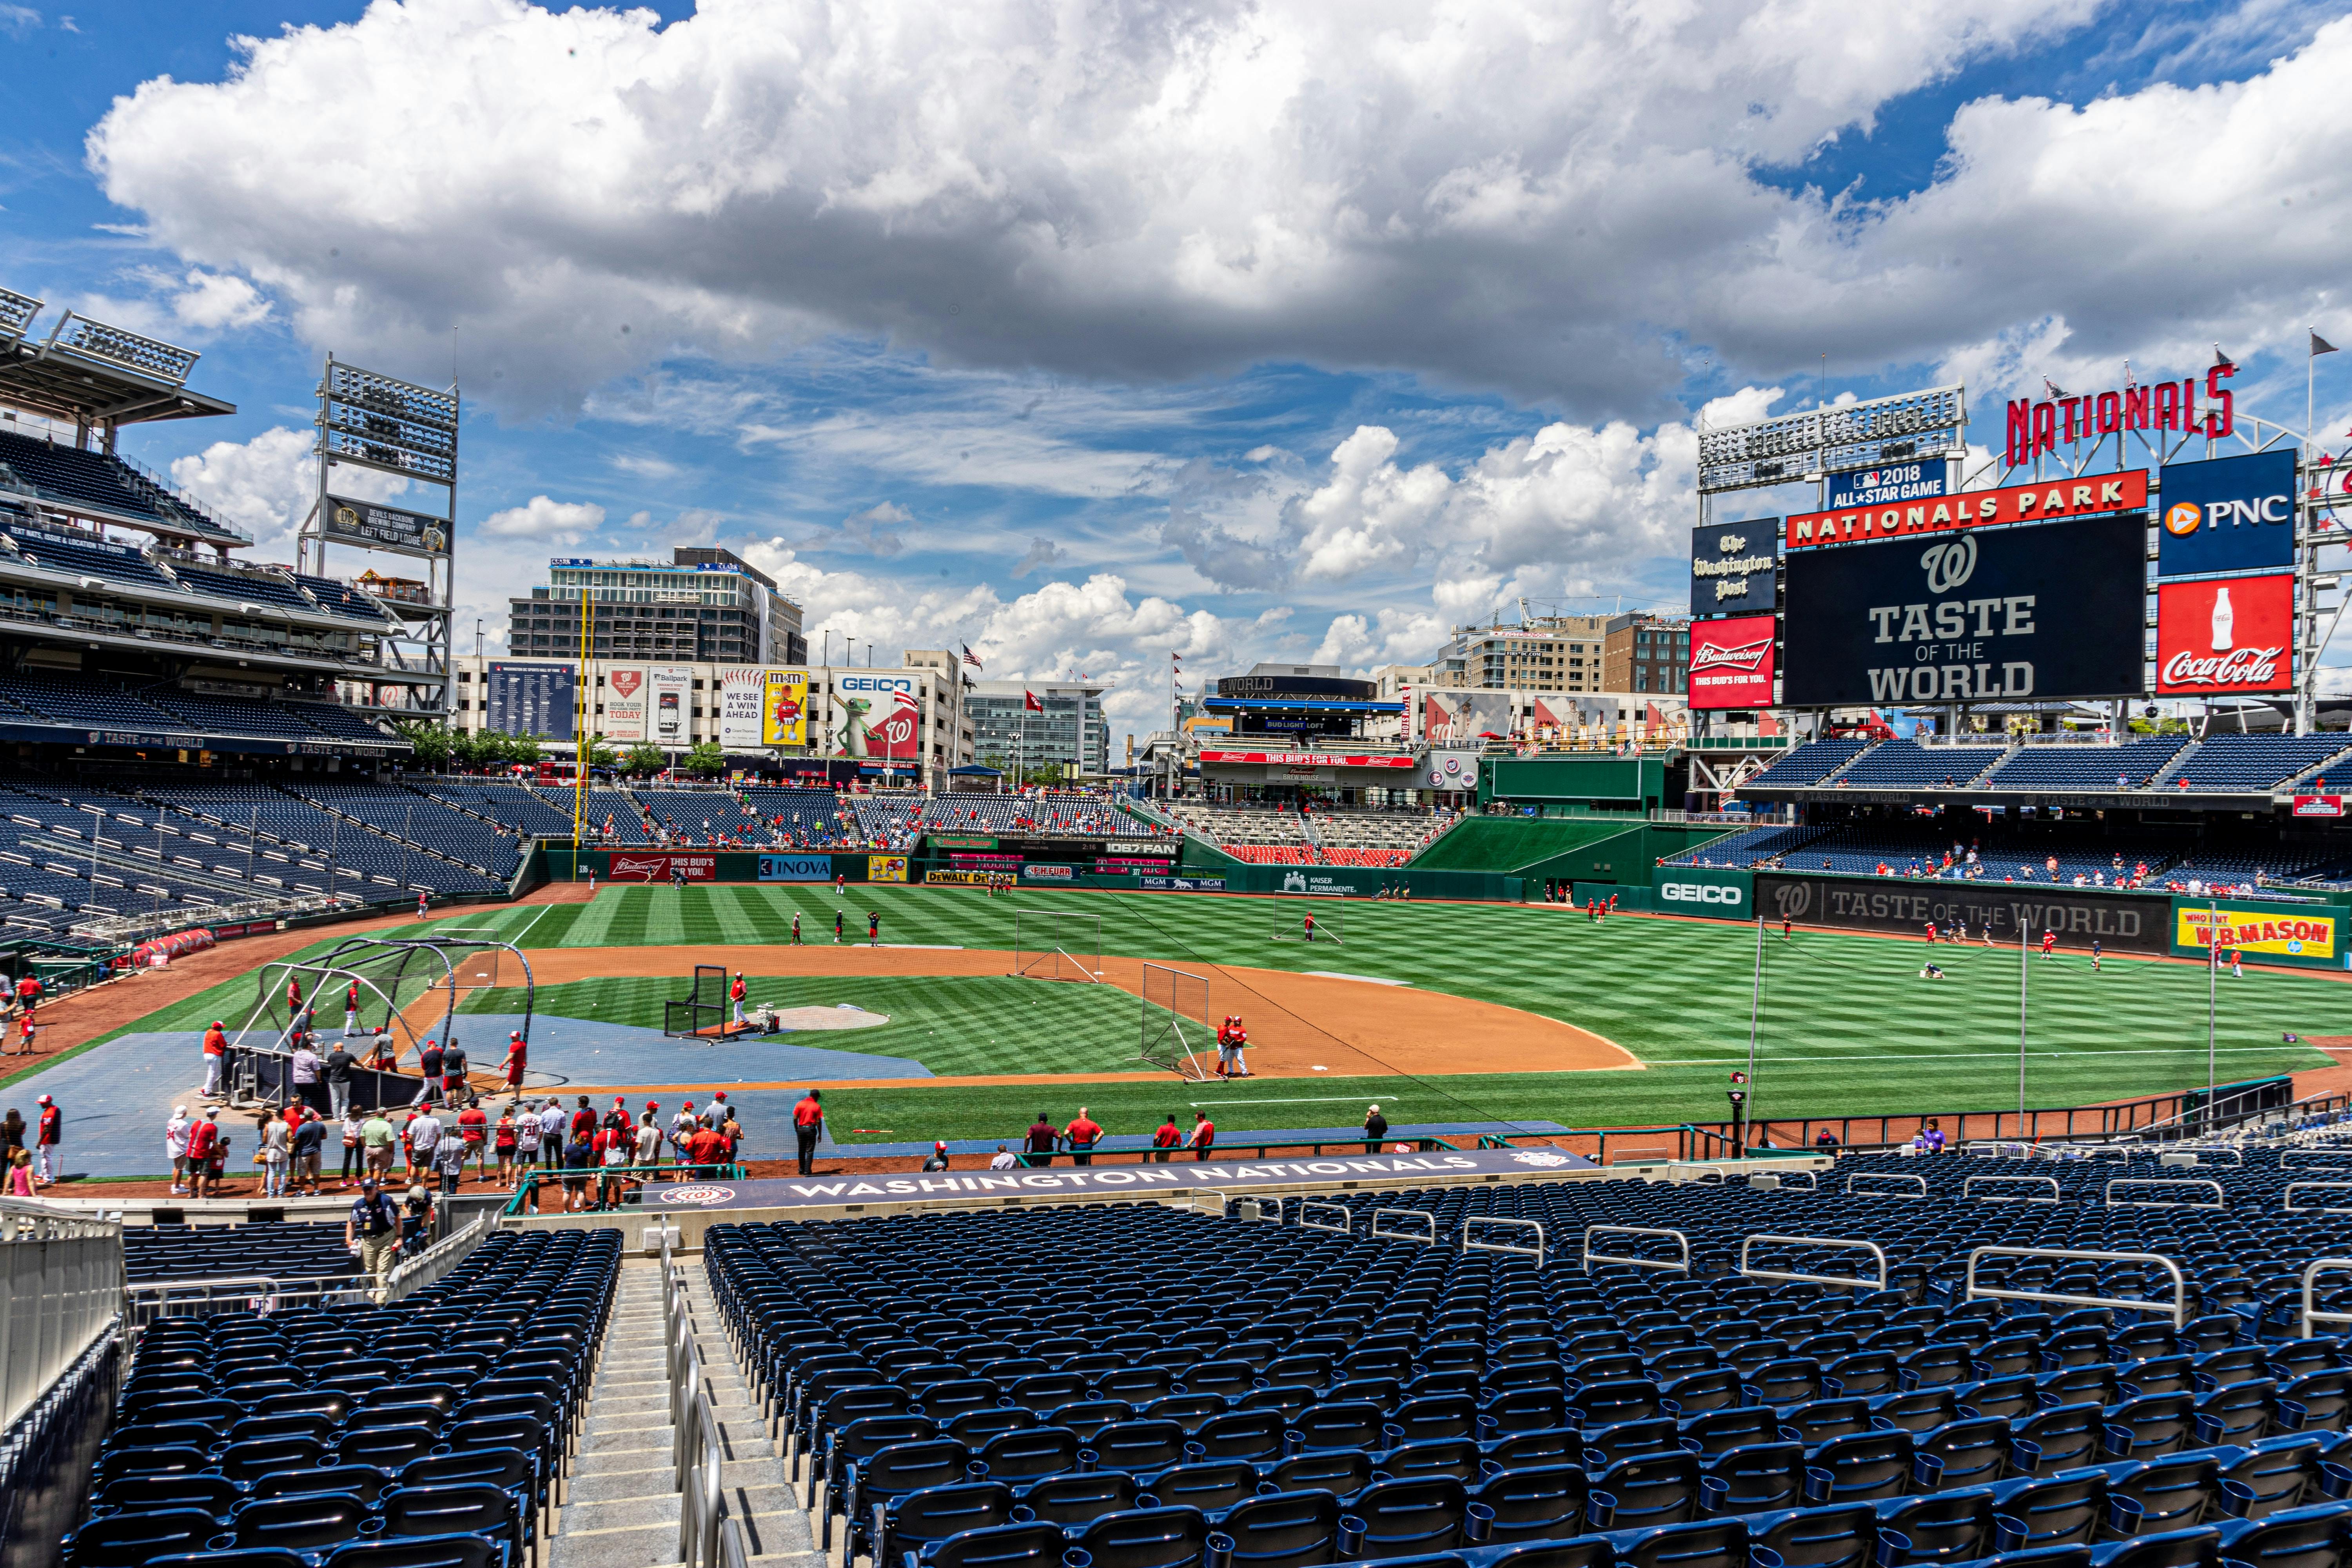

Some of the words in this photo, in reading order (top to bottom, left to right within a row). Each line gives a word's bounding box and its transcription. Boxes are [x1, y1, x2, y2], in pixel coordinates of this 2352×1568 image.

[2006, 363, 2234, 467] NATIONALS
[1882, 465, 1920, 486] 2018
[1901, 479, 1942, 499] GAME
[369, 509, 387, 519] DEVILS
[388, 513, 415, 524] BACKBONE
[1797, 497, 1997, 540] NATIONALS
[2019, 481, 2123, 513] PARK
[2205, 495, 2288, 528] PNC
[368, 515, 391, 528] BREWING
[392, 521, 416, 532] COMPANY
[44, 533, 62, 543] ISSUE
[68, 538, 96, 549] LOCATION
[361, 525, 378, 537] LEFT
[379, 530, 398, 541] FIELD
[400, 533, 421, 546] LODGE
[1720, 535, 1746, 553] The
[1693, 555, 1774, 576] Washington
[1715, 578, 1748, 601] Post
[1869, 595, 2036, 643] TASTE
[1696, 649, 1763, 663] Budweiser
[1916, 645, 1940, 661] OF
[1945, 642, 1984, 660] THE
[2162, 646, 2284, 684] Coca-Cola
[842, 677, 911, 692] GEICO
[1228, 677, 1273, 691] WORLD
[1695, 677, 1711, 686] THIS
[1711, 676, 1733, 685] BUD'S
[1734, 675, 1748, 684] FOR
[1749, 675, 1766, 683] YOU.
[1867, 661, 2034, 701] WORLD
[609, 711, 641, 719] TODAY
[1402, 699, 1410, 716] TEAM
[1401, 717, 1410, 738] STORE
[105, 733, 140, 744] TASTE
[165, 737, 204, 748] WORLD
[301, 744, 332, 755] TASTE
[355, 747, 387, 757] WORLD
[1266, 753, 1283, 762] THIS
[1285, 754, 1310, 764] BUD'S
[1312, 755, 1328, 764] FOR
[1330, 756, 1348, 765] YOU.
[2042, 795, 2085, 806] TASTE
[2118, 796, 2170, 807] WORLD
[1107, 843, 1140, 853] 106.7
[1143, 844, 1176, 854] FAN
[670, 858, 688, 866] THIS
[690, 858, 714, 866] BUD'S
[777, 861, 829, 874] INOVA
[687, 867, 706, 876] YOU.
[1661, 882, 1741, 904] GEICO
[1832, 891, 1929, 921] TASTE
[1933, 903, 1959, 920] OF
[1965, 905, 2006, 925] THE
[2010, 903, 2141, 936] WORLD
[2186, 914, 2207, 922] WHO
[2288, 942, 2301, 953] hp
[524, 1125, 535, 1136] 31
[789, 1169, 1179, 1198] WASHINGTON
[1189, 1156, 1477, 1179] NATIONALS
[666, 1186, 728, 1195] WASHINGTON
